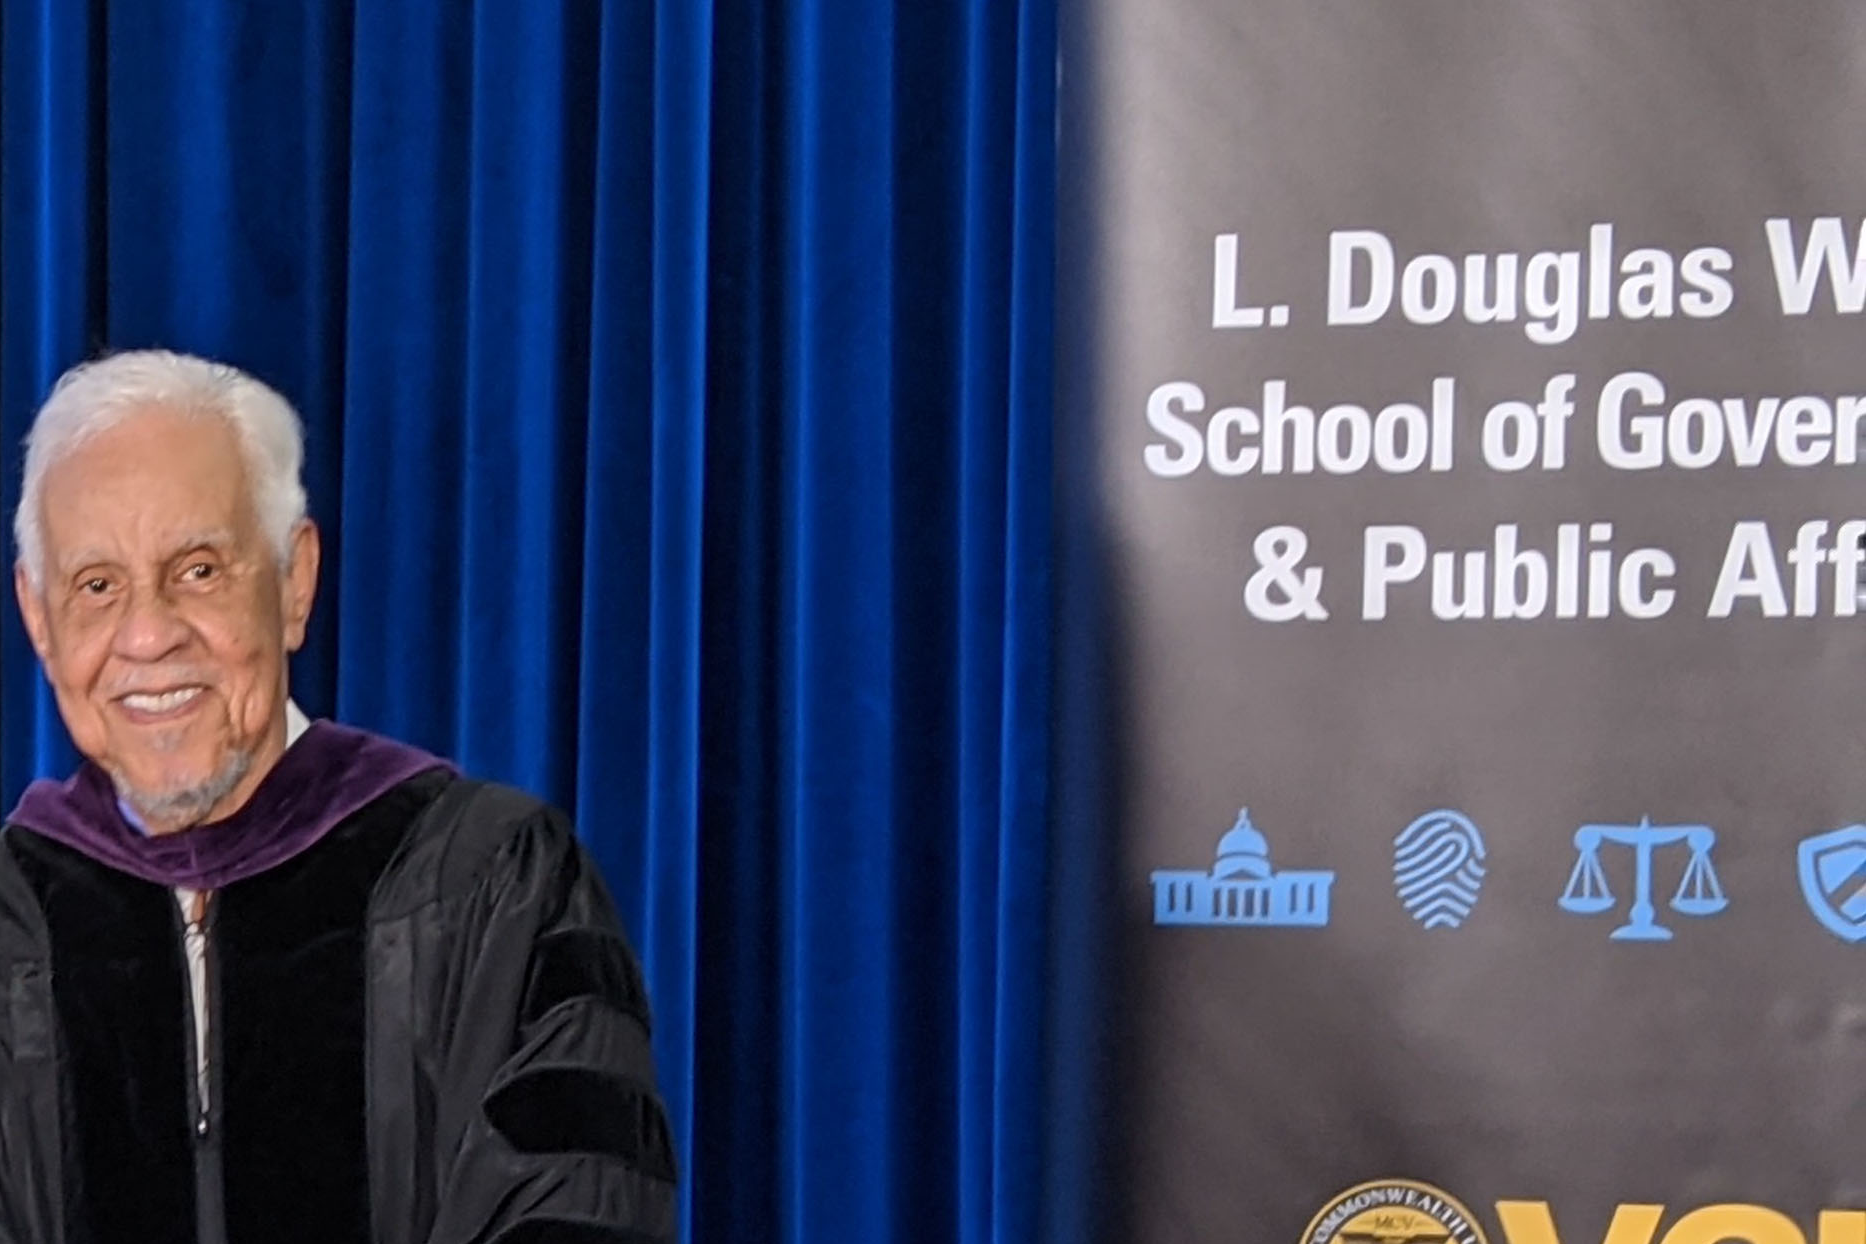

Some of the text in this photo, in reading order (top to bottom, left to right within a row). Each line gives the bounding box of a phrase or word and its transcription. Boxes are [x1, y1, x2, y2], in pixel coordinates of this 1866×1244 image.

[1212, 233, 1289, 328] L.
[1327, 223, 1733, 345] Douglas
[1143, 372, 1866, 477] School of Gover
[1244, 520, 1866, 622] & Public Aff
